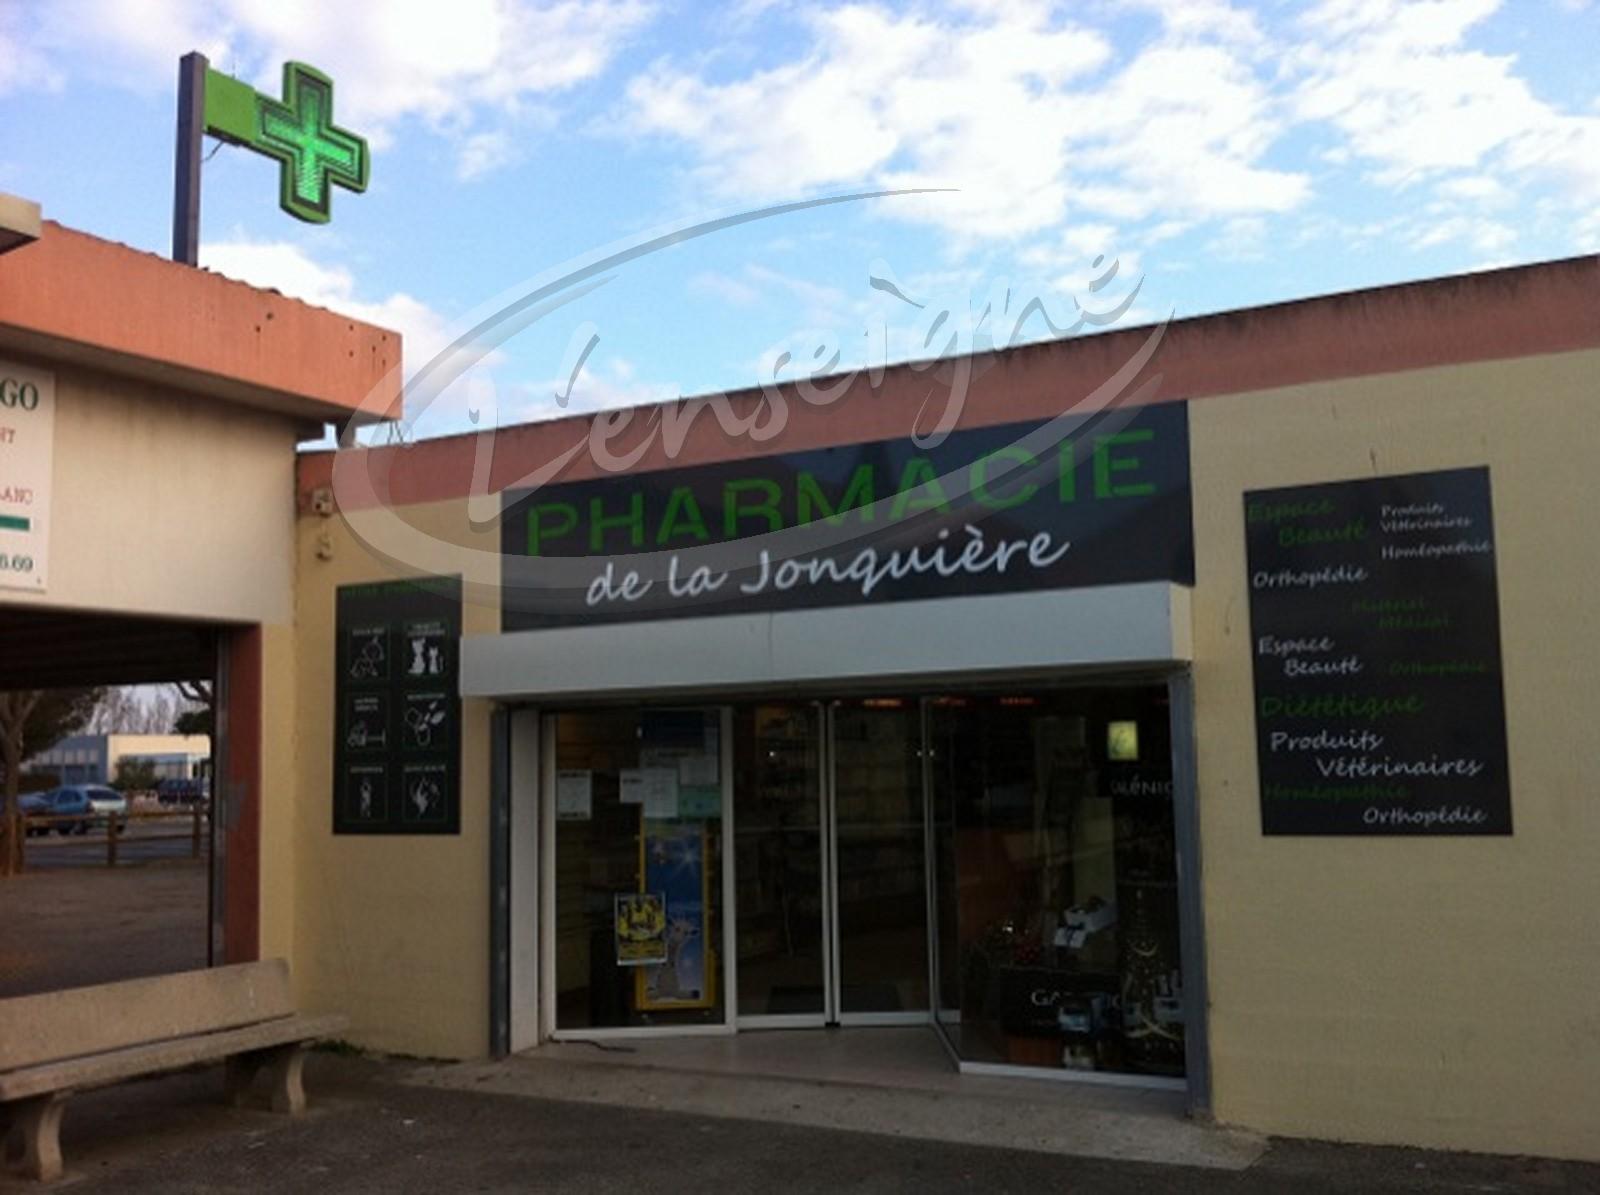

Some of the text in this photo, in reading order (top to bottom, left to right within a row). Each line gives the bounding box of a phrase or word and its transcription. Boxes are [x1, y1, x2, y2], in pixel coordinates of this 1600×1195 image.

[526, 428, 1157, 557] PHARMACIE
[1381, 503, 1445, 518] Produits
[1380, 516, 1473, 532] Vétérinaires
[1381, 539, 1493, 561] Homéopathie
[586, 525, 1071, 606] de la Jonquière
[1253, 565, 1369, 589] Orthopédie
[1258, 635, 1335, 657] Espace
[1283, 656, 1364, 677] Beauté
[1270, 729, 1384, 752] Produits
[1315, 754, 1485, 778] Vétérinaires
[1363, 805, 1488, 829] Orthopédie
